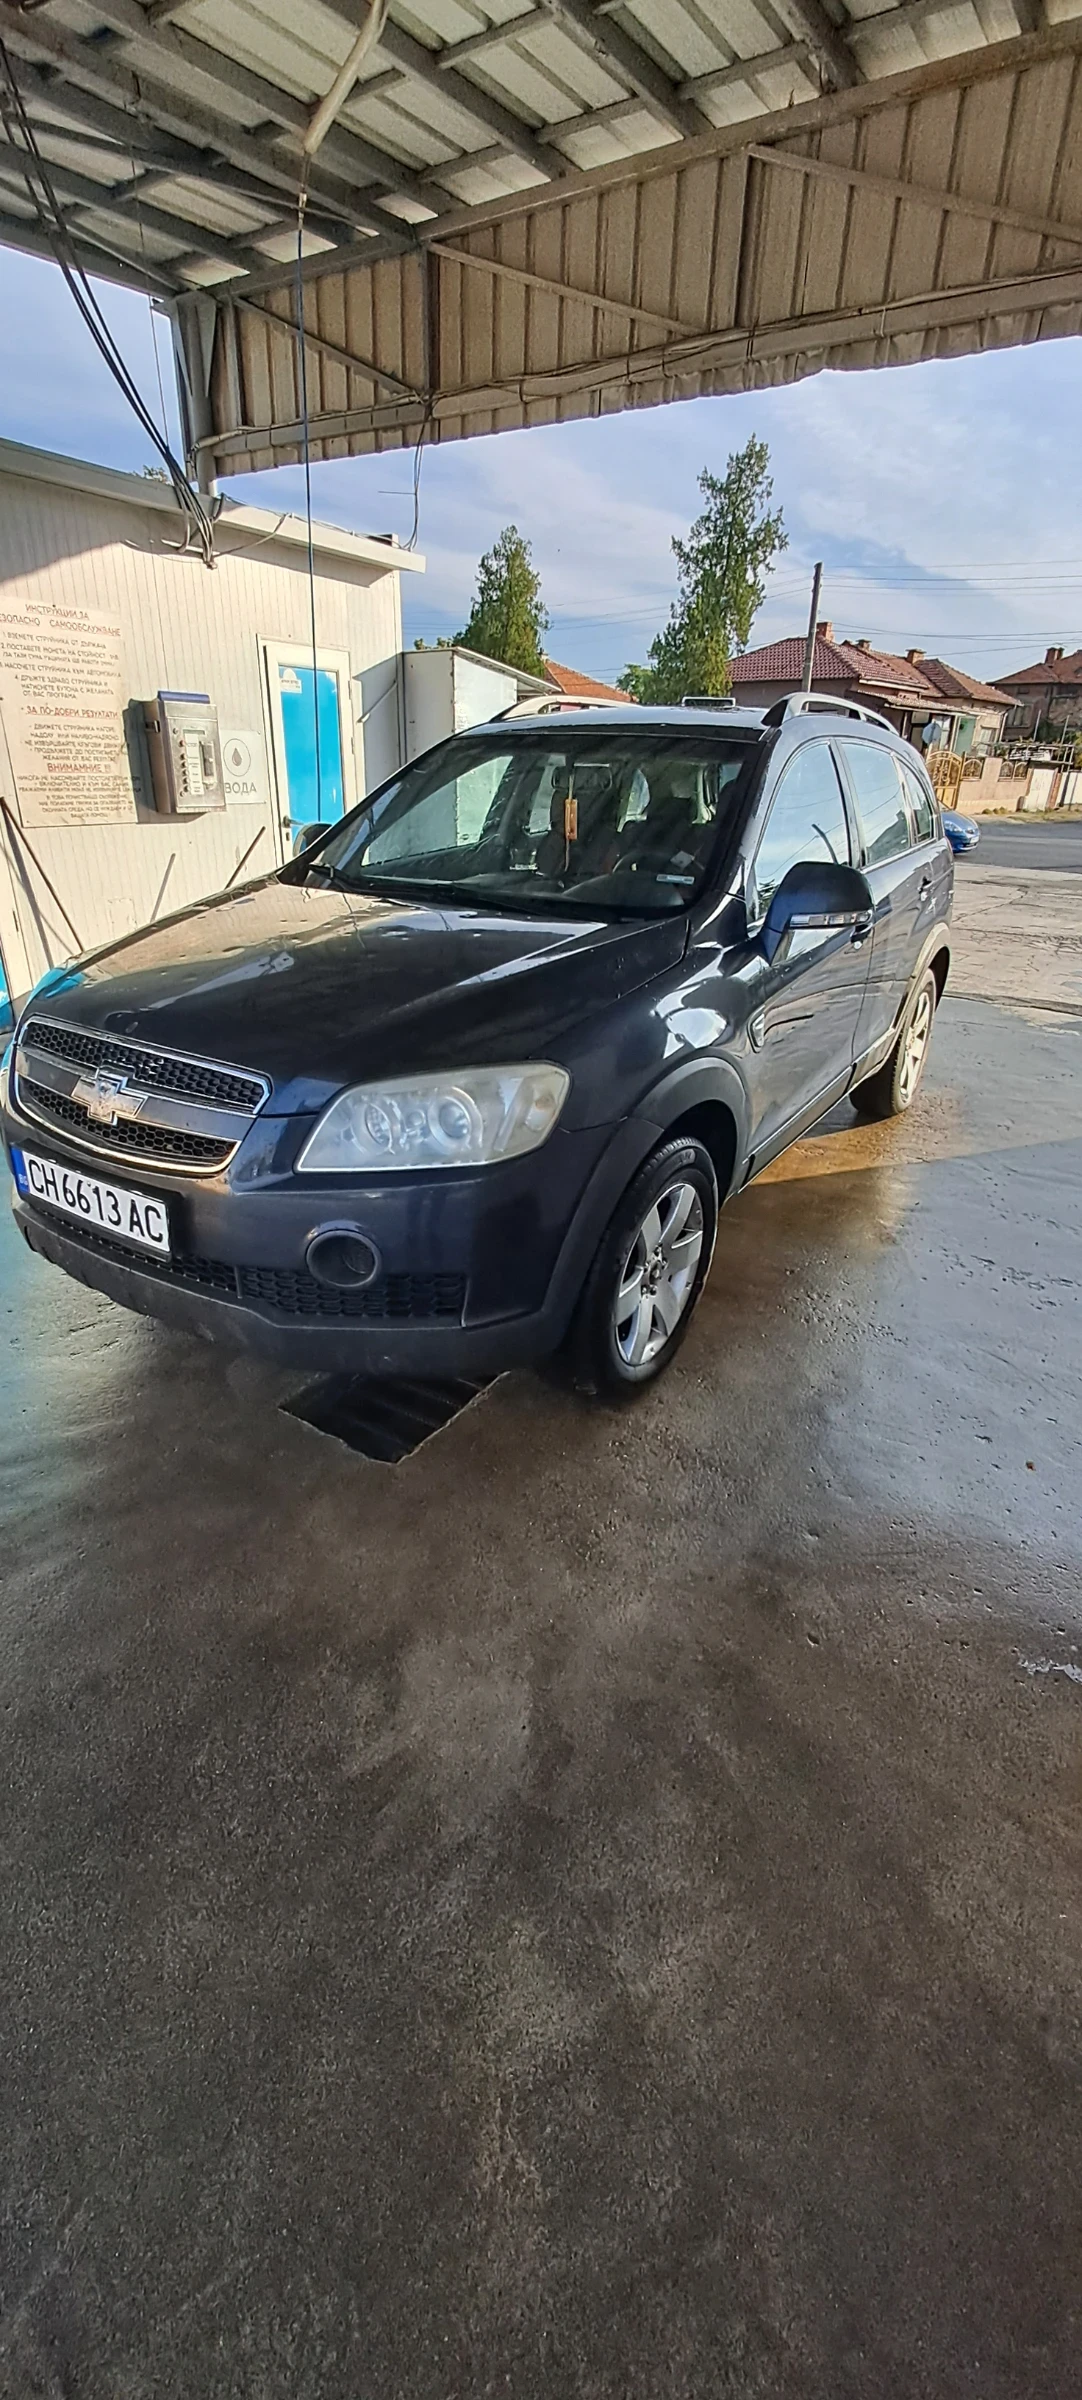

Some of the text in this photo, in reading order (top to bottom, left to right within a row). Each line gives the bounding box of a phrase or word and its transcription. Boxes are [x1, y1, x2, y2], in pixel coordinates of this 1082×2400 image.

[25, 603, 90, 620] ИНСТРУКЦИИ ЗА
[26, 705, 118, 719] ЗА ПО-ДОБРИ РЕЗУЛТАТИ
[225, 783, 257, 794] ВОДА
